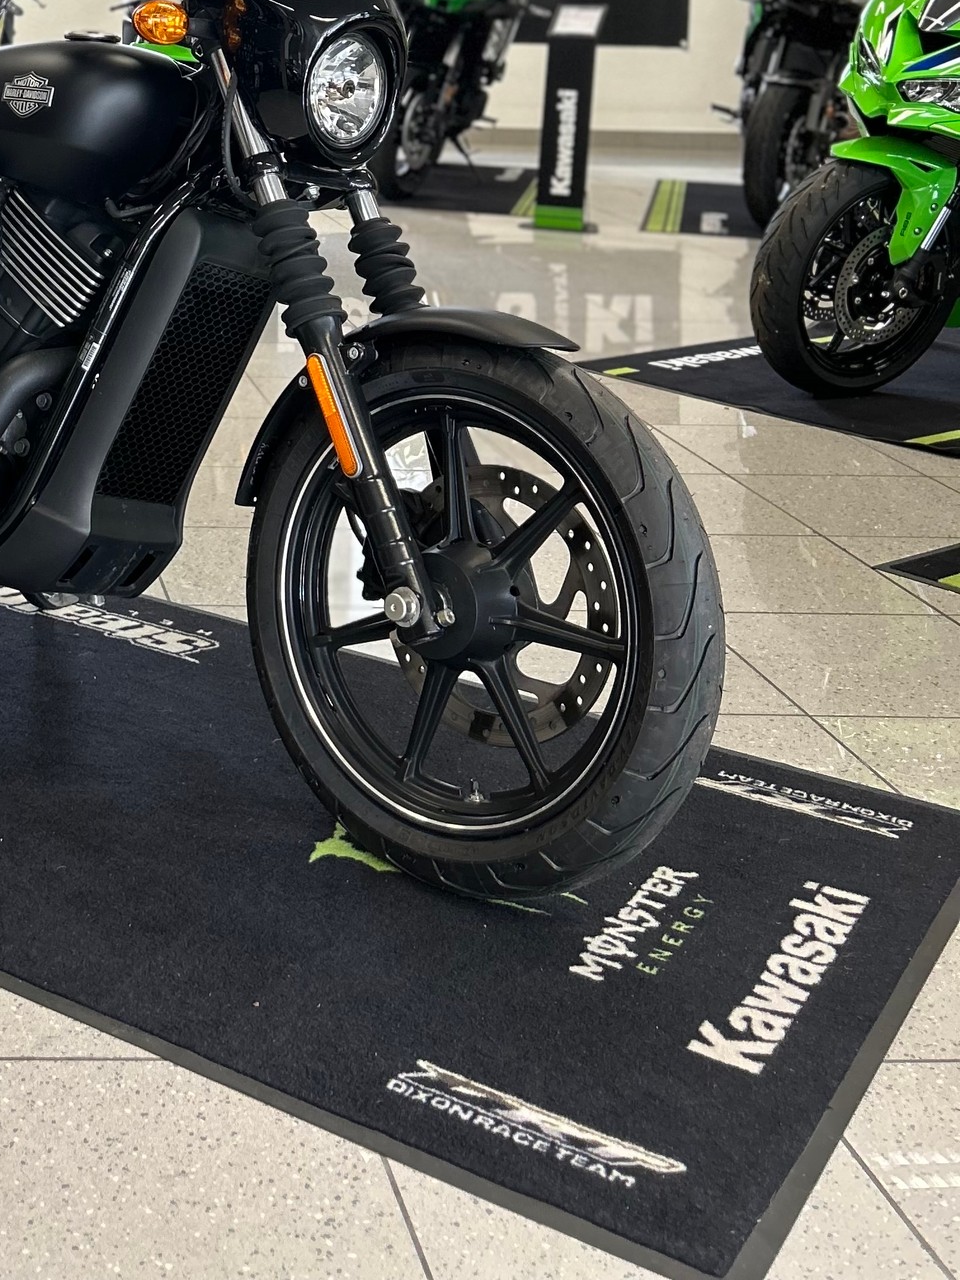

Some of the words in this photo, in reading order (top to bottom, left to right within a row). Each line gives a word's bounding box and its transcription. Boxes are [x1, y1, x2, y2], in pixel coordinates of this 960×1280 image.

[550, 88, 579, 197] Kawasaki
[717, 770, 777, 790] TEAM
[636, 893, 715, 975] ENERGY
[686, 880, 871, 1074] Kawasaki
[554, 1147, 636, 1187] TEAM
